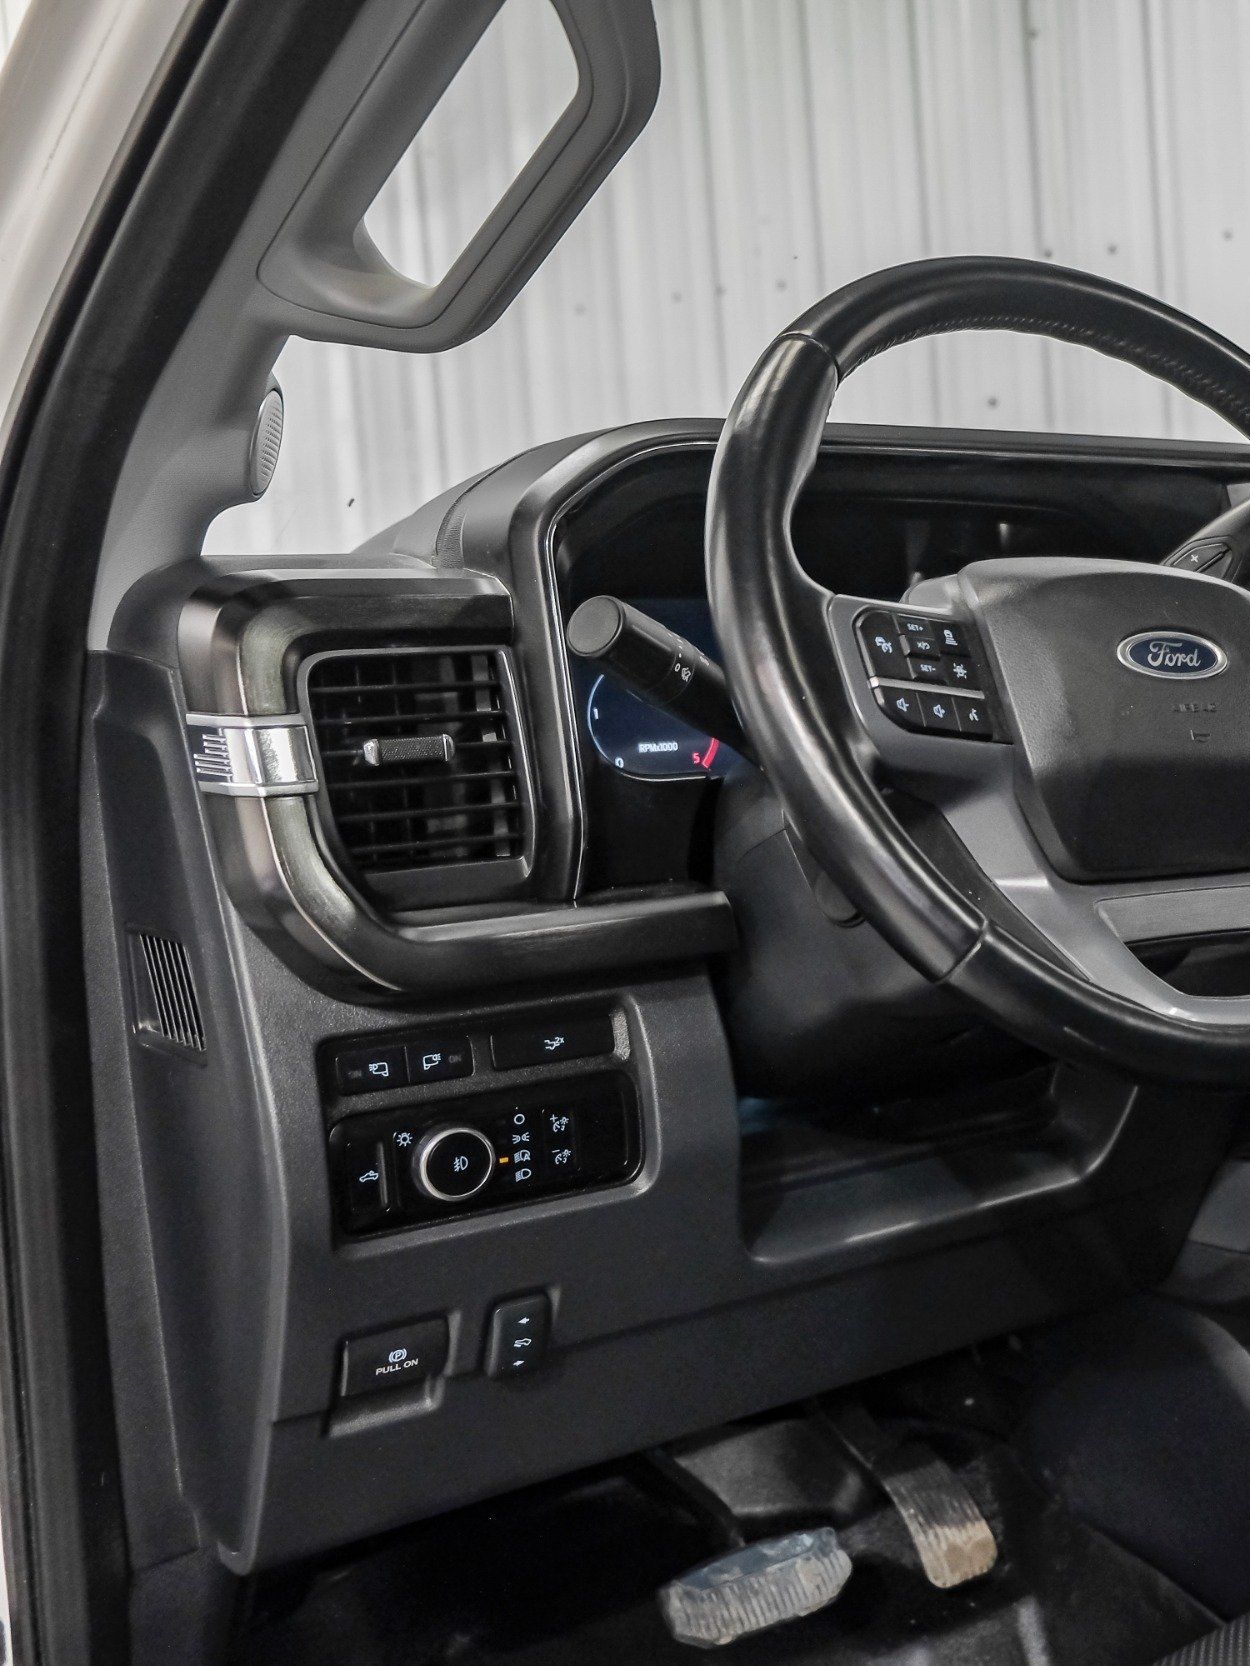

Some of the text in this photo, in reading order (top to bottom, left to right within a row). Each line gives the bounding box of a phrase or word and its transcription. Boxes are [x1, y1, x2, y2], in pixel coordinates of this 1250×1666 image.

[906, 622, 924, 632] SET+
[1147, 641, 1201, 667] Ford
[375, 1358, 419, 1375] PULL ON
